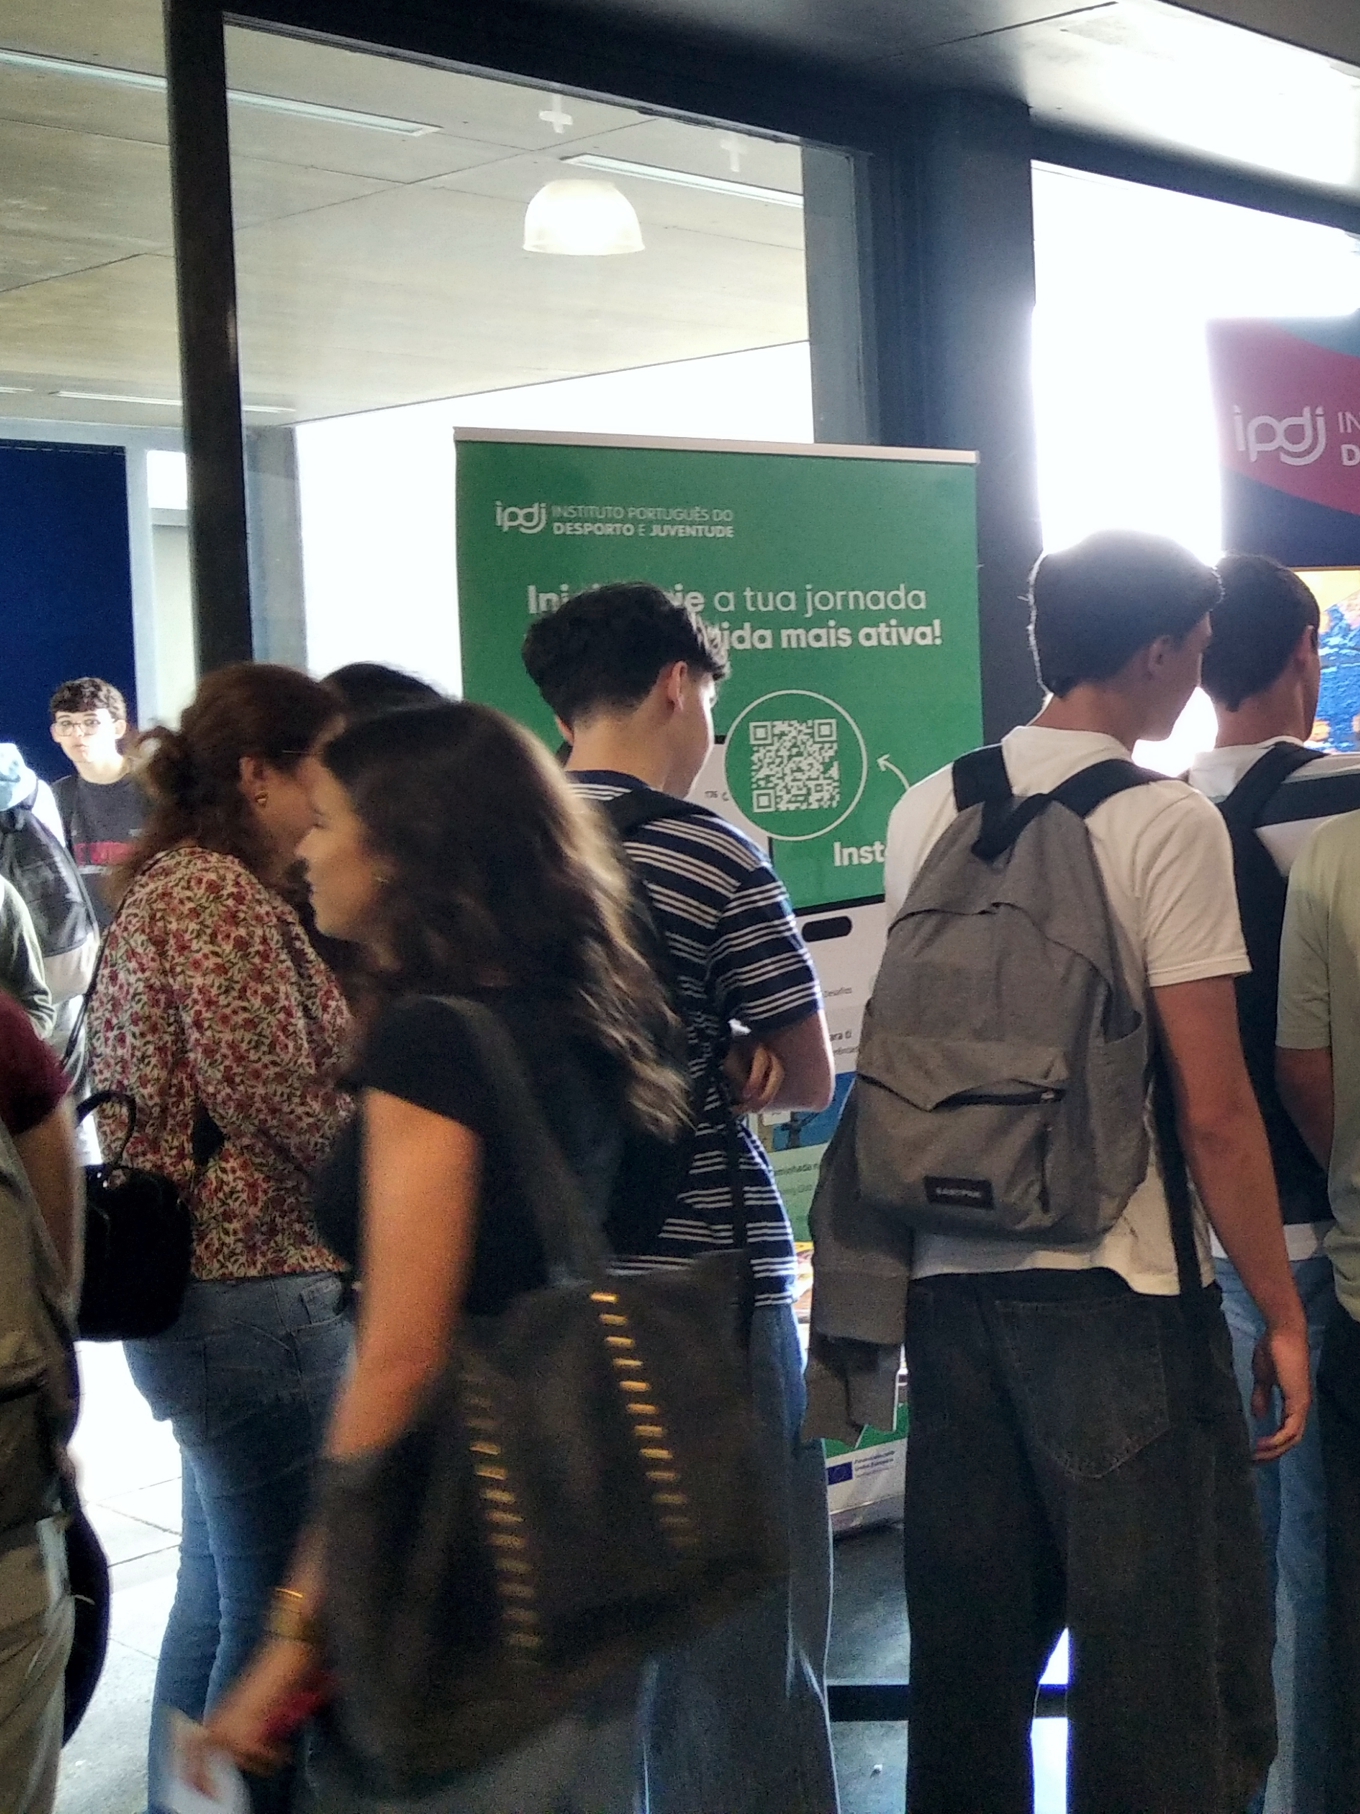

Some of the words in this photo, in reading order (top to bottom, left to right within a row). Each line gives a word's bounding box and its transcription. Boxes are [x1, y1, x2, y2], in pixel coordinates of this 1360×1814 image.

[1232, 404, 1327, 466] ipdj
[496, 501, 548, 534] ipdj
[551, 506, 625, 519] INSTITUTO
[628, 506, 709, 521] PORTUGUÊS
[713, 509, 734, 522] DO
[552, 522, 635, 536] DESPORTO
[638, 524, 646, 536] E
[650, 524, 735, 538] JUVENTUDE
[714, 591, 735, 612] a
[743, 587, 797, 612] tua
[804, 584, 926, 618] jornada
[780, 619, 852, 649] mais
[858, 618, 943, 647] ativa!
